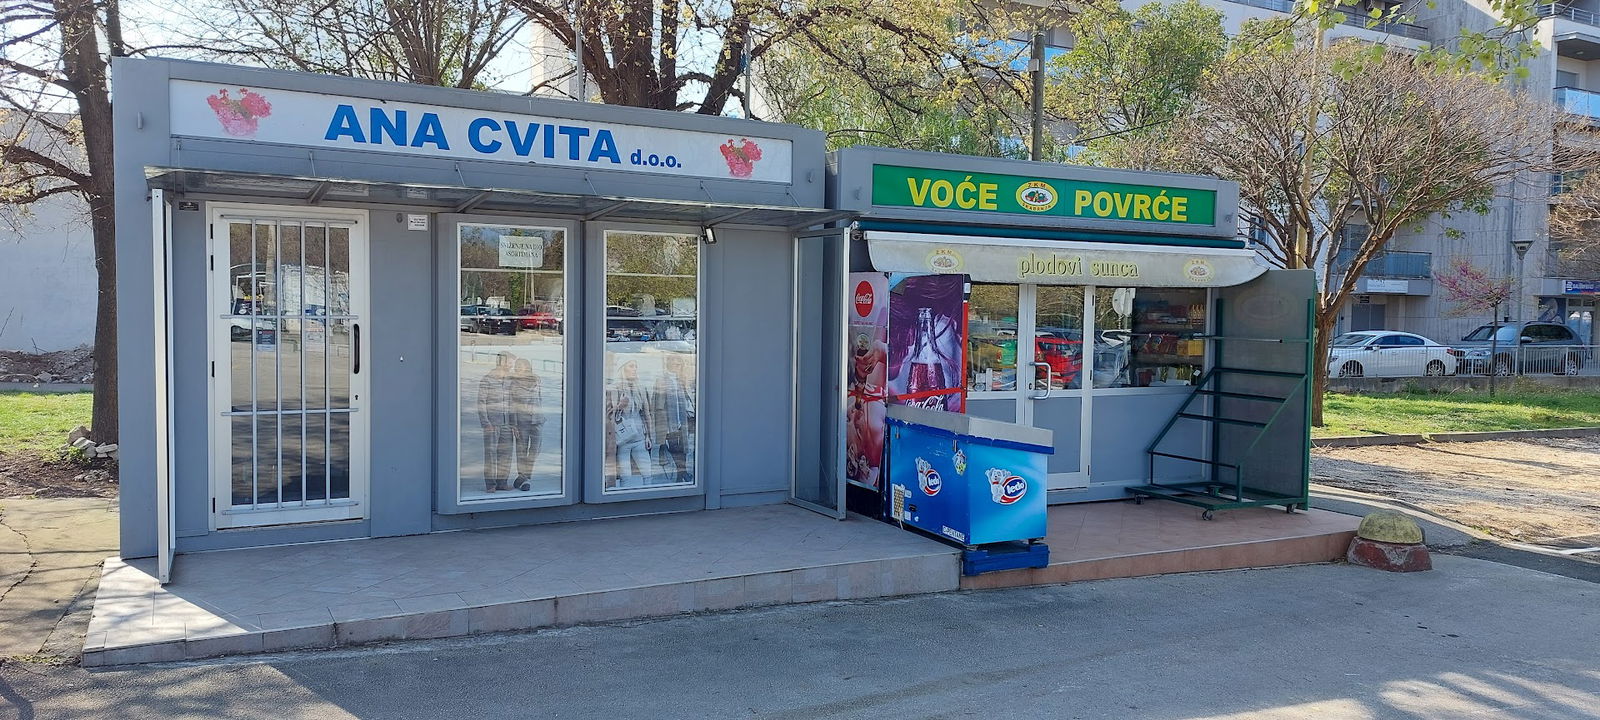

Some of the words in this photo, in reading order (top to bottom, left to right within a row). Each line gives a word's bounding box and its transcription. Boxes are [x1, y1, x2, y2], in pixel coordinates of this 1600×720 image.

[324, 104, 451, 150] ANA
[467, 117, 622, 164] CVITA
[630, 149, 682, 168] d.o.o.
[906, 175, 998, 211] VOĆE
[1074, 189, 1188, 222] POVRĆE
[1017, 251, 1083, 279] plodovi
[1090, 260, 1140, 278] sunca
